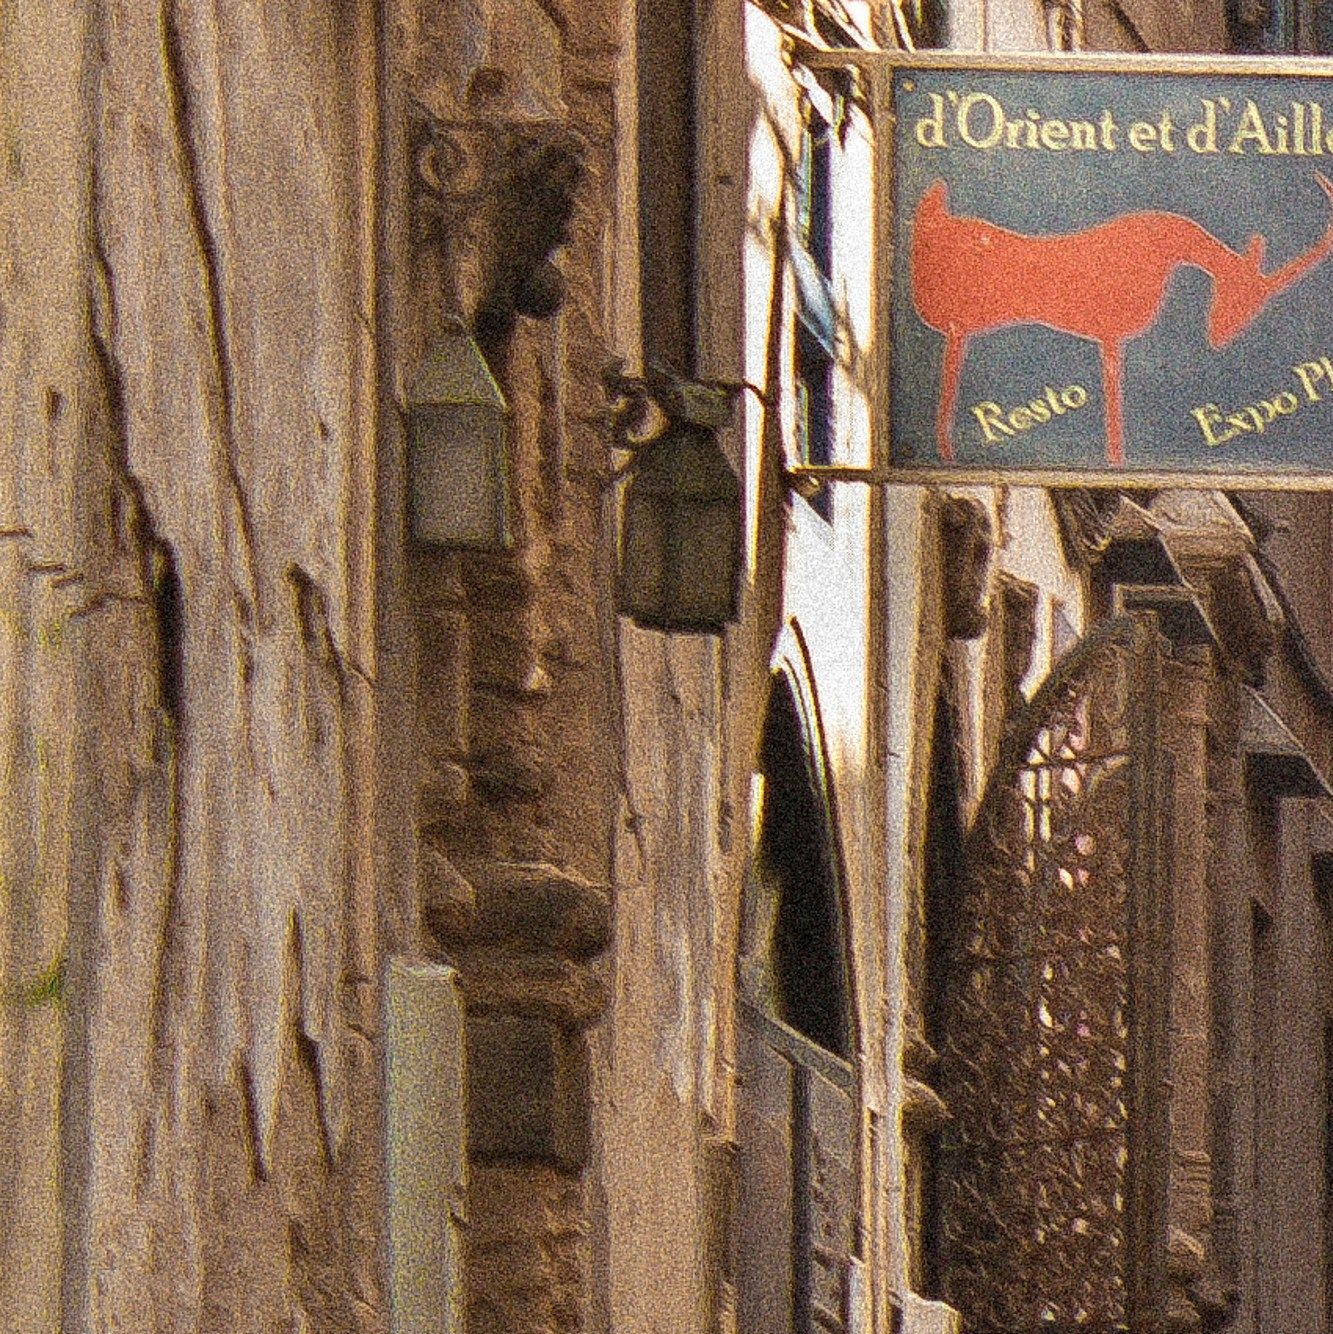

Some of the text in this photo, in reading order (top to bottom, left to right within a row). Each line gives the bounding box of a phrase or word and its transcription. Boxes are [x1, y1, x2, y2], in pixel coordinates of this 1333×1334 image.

[915, 92, 1116, 152] d'Orient
[1129, 111, 1174, 152] et
[973, 382, 1089, 444] Resto
[1193, 390, 1299, 447] Expo
